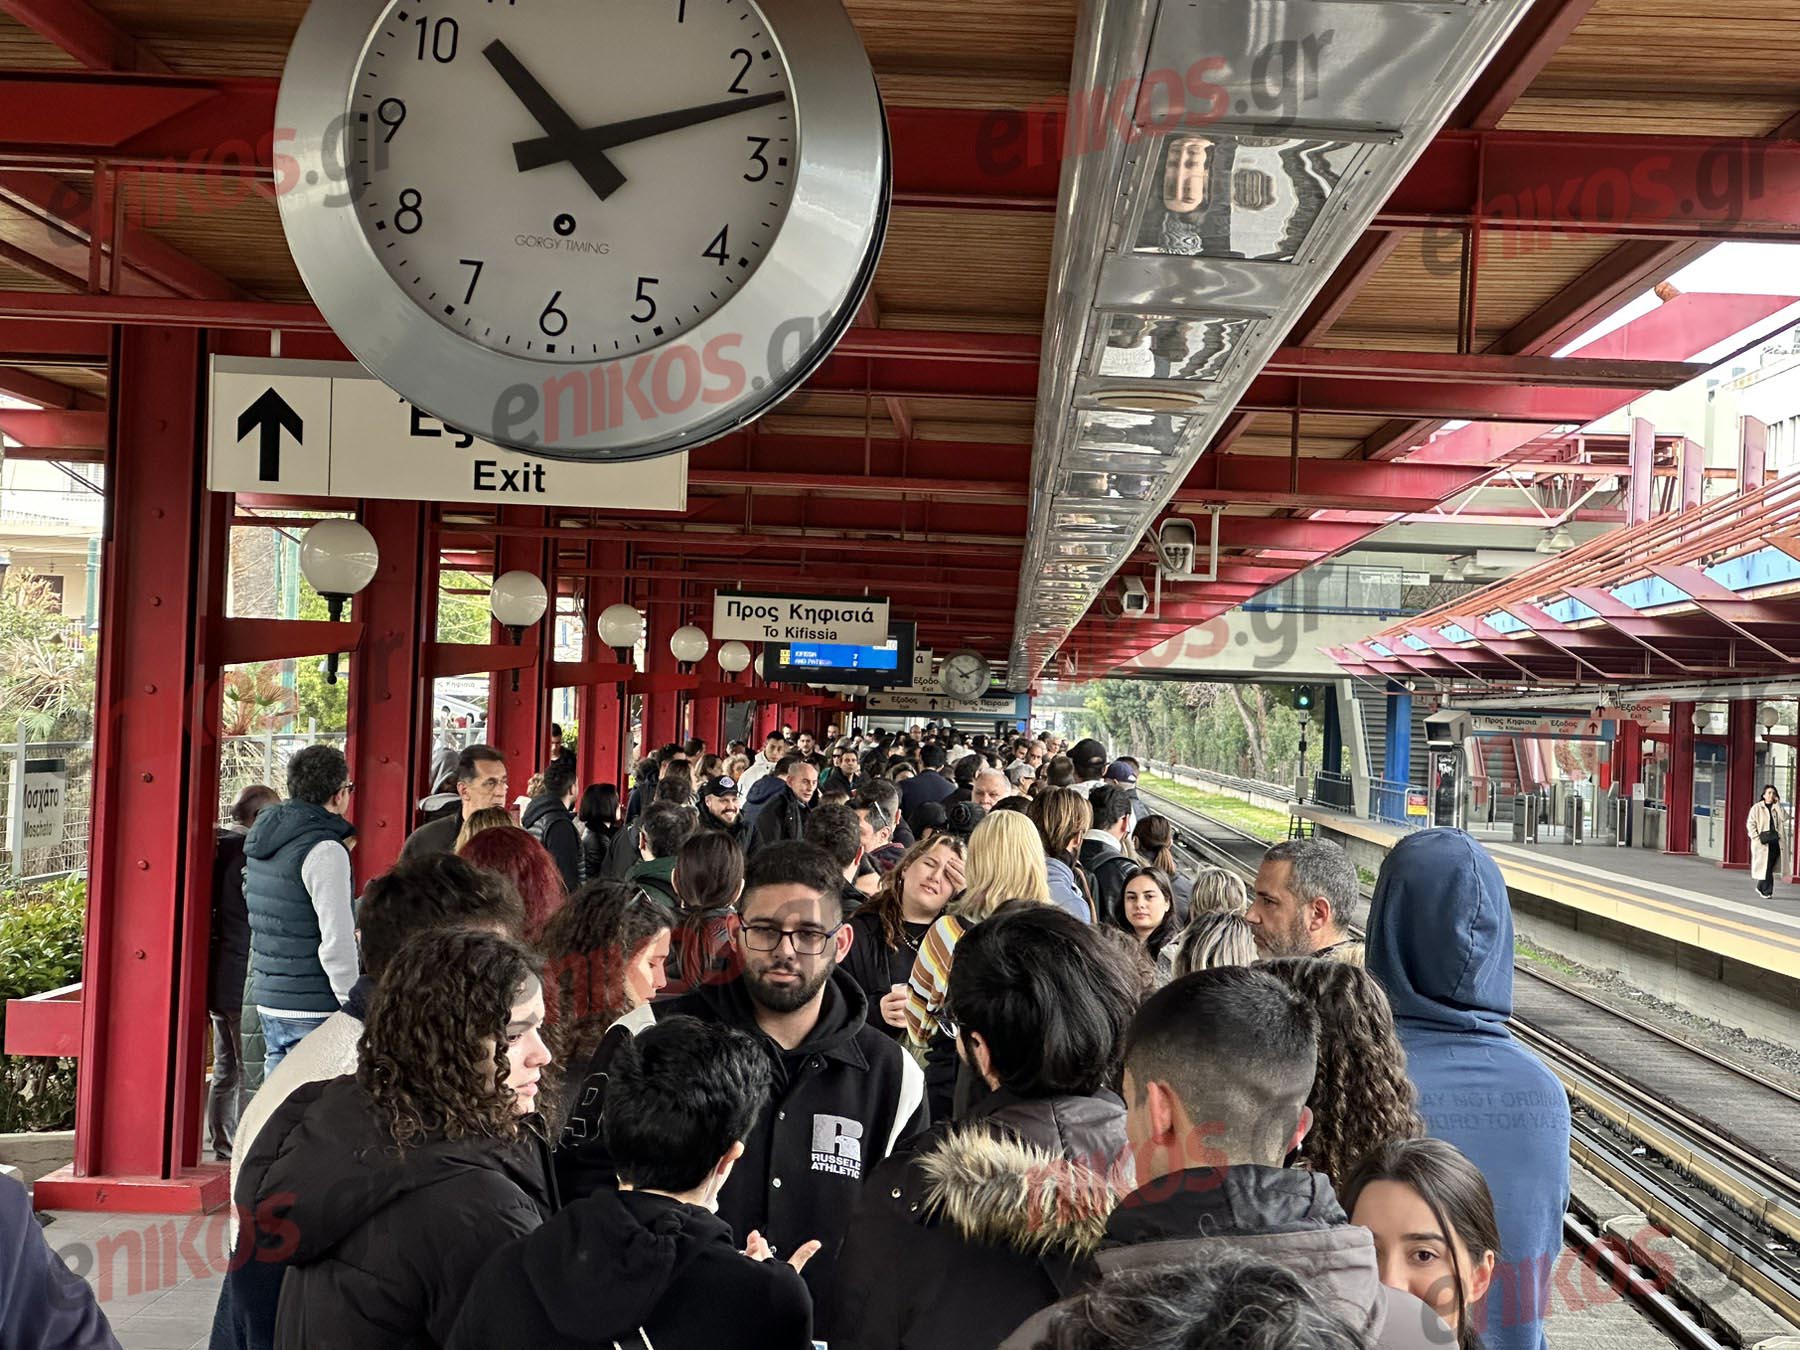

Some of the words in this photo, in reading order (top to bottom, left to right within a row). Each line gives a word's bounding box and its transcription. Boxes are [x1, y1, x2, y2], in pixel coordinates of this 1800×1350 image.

[415, 16, 459, 63] 10
[727, 48, 753, 94] 2
[377, 97, 407, 144] 9
[743, 136, 770, 182] 3
[394, 188, 422, 234] 8
[514, 235, 562, 250] GORGY
[565, 240, 610, 254] TIMING
[702, 224, 731, 266] 4
[459, 259, 484, 305] 7
[630, 277, 659, 323] 5
[538, 291, 568, 337] 6
[473, 460, 546, 493] Exit
[727, 601, 779, 622] Προς
[790, 603, 874, 625] Κηφισιά
[763, 625, 779, 638] To
[785, 627, 838, 640] Kifissia
[913, 677, 939, 686] Εξοδο
[811, 1113, 864, 1162] R
[810, 1161, 860, 1180] ATHLETIC
[811, 1152, 862, 1171] RUSSELL
